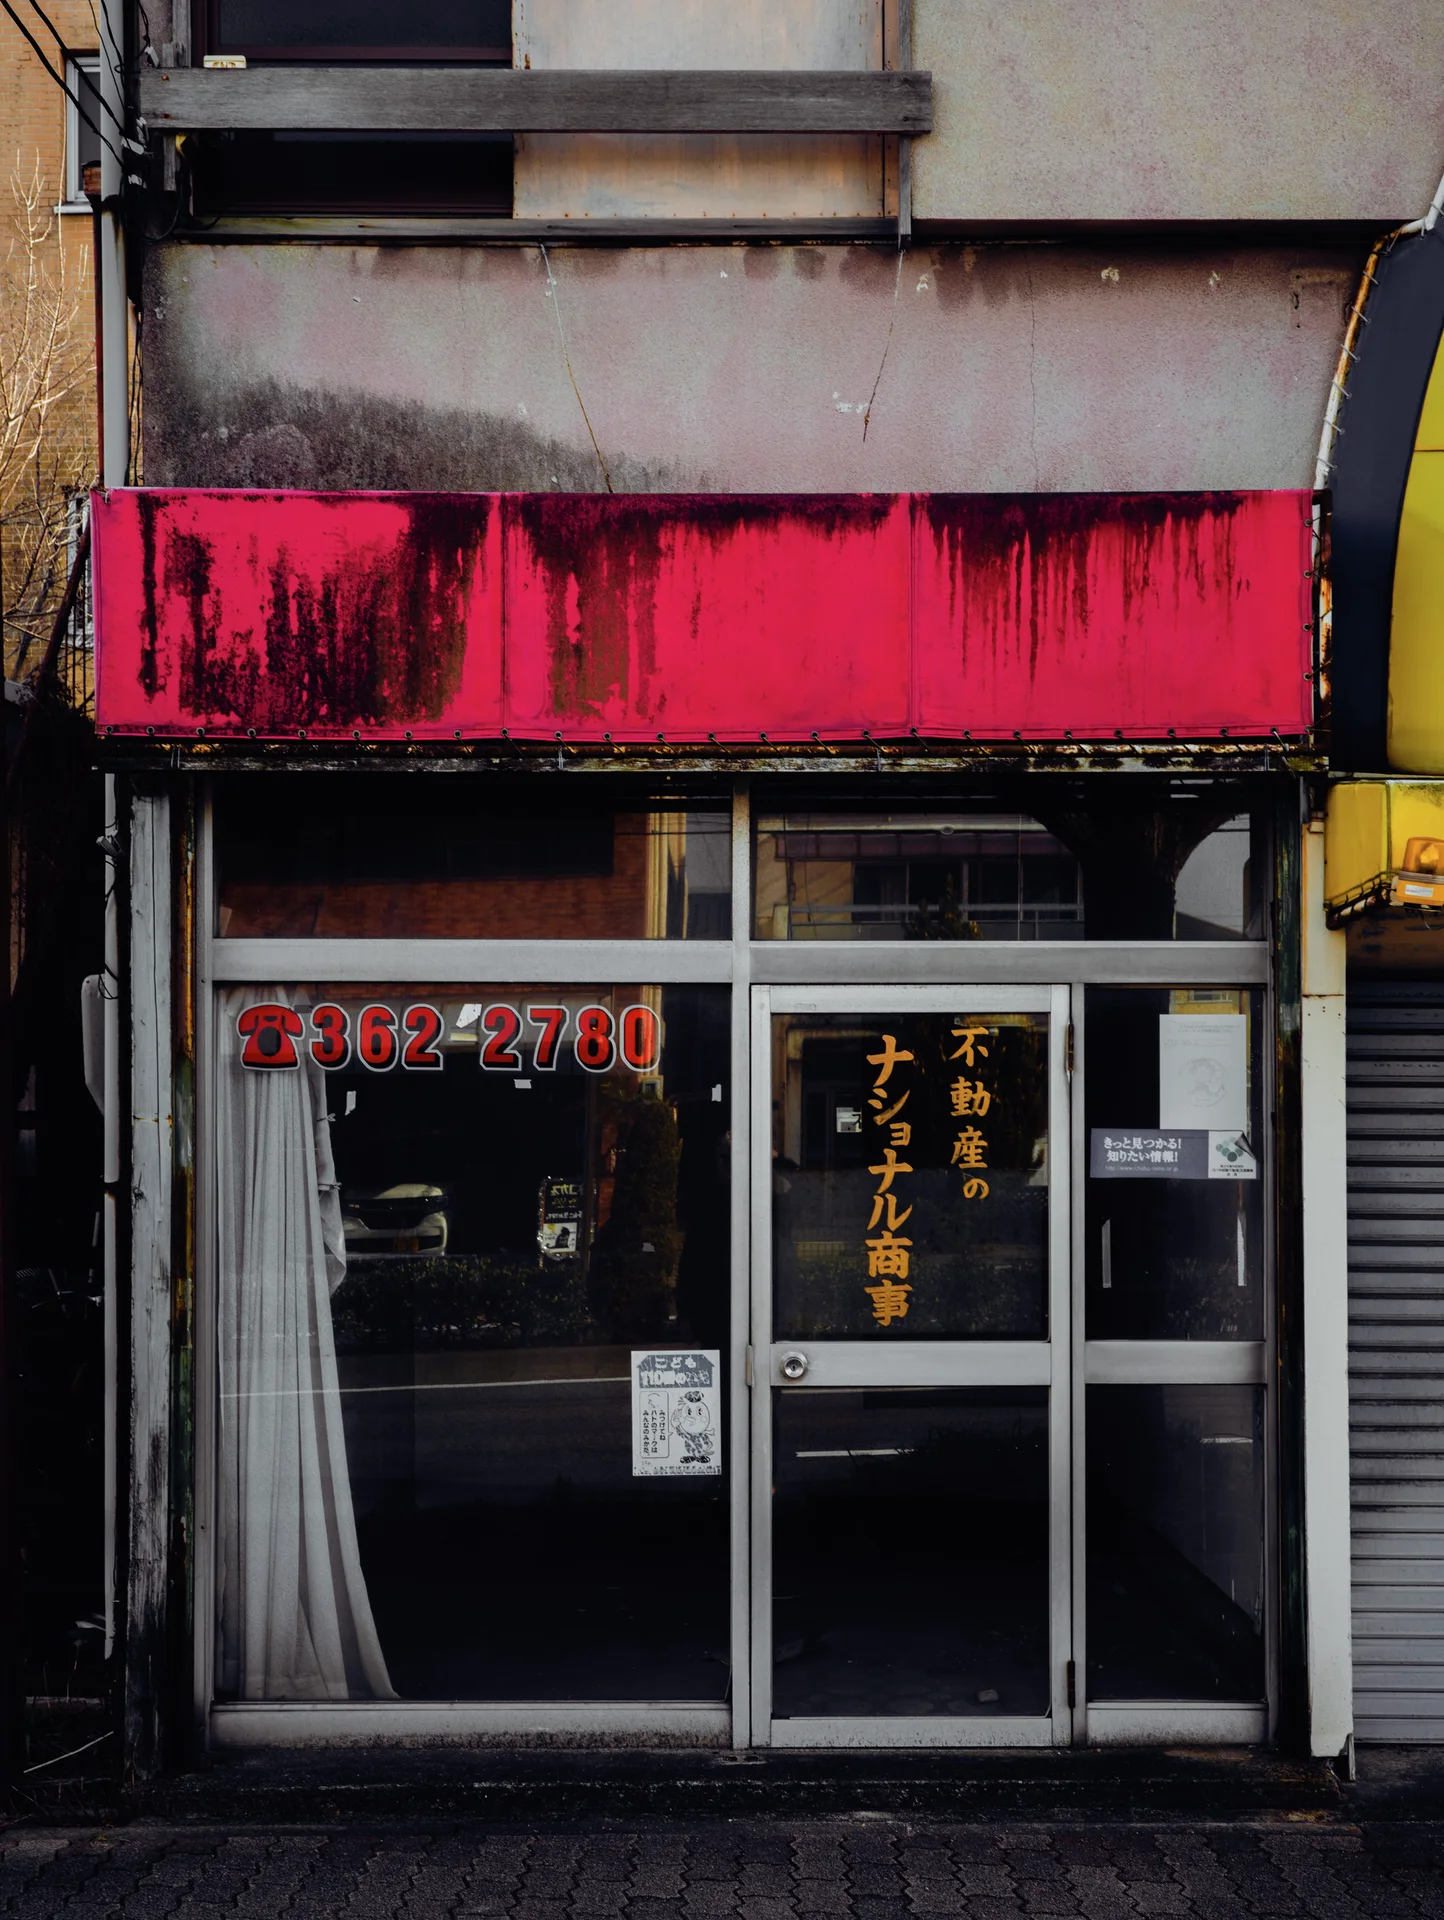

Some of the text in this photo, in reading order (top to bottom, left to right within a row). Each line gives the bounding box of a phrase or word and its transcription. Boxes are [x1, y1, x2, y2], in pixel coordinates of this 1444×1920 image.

[309, 1003, 662, 1072] 362 2780
[949, 1026, 991, 1200] 不動産の
[1103, 1136, 1182, 1150] きっと見つかる!
[863, 1034, 914, 1327] ナショナル商事
[1106, 1150, 1179, 1163] 知りたい情報!
